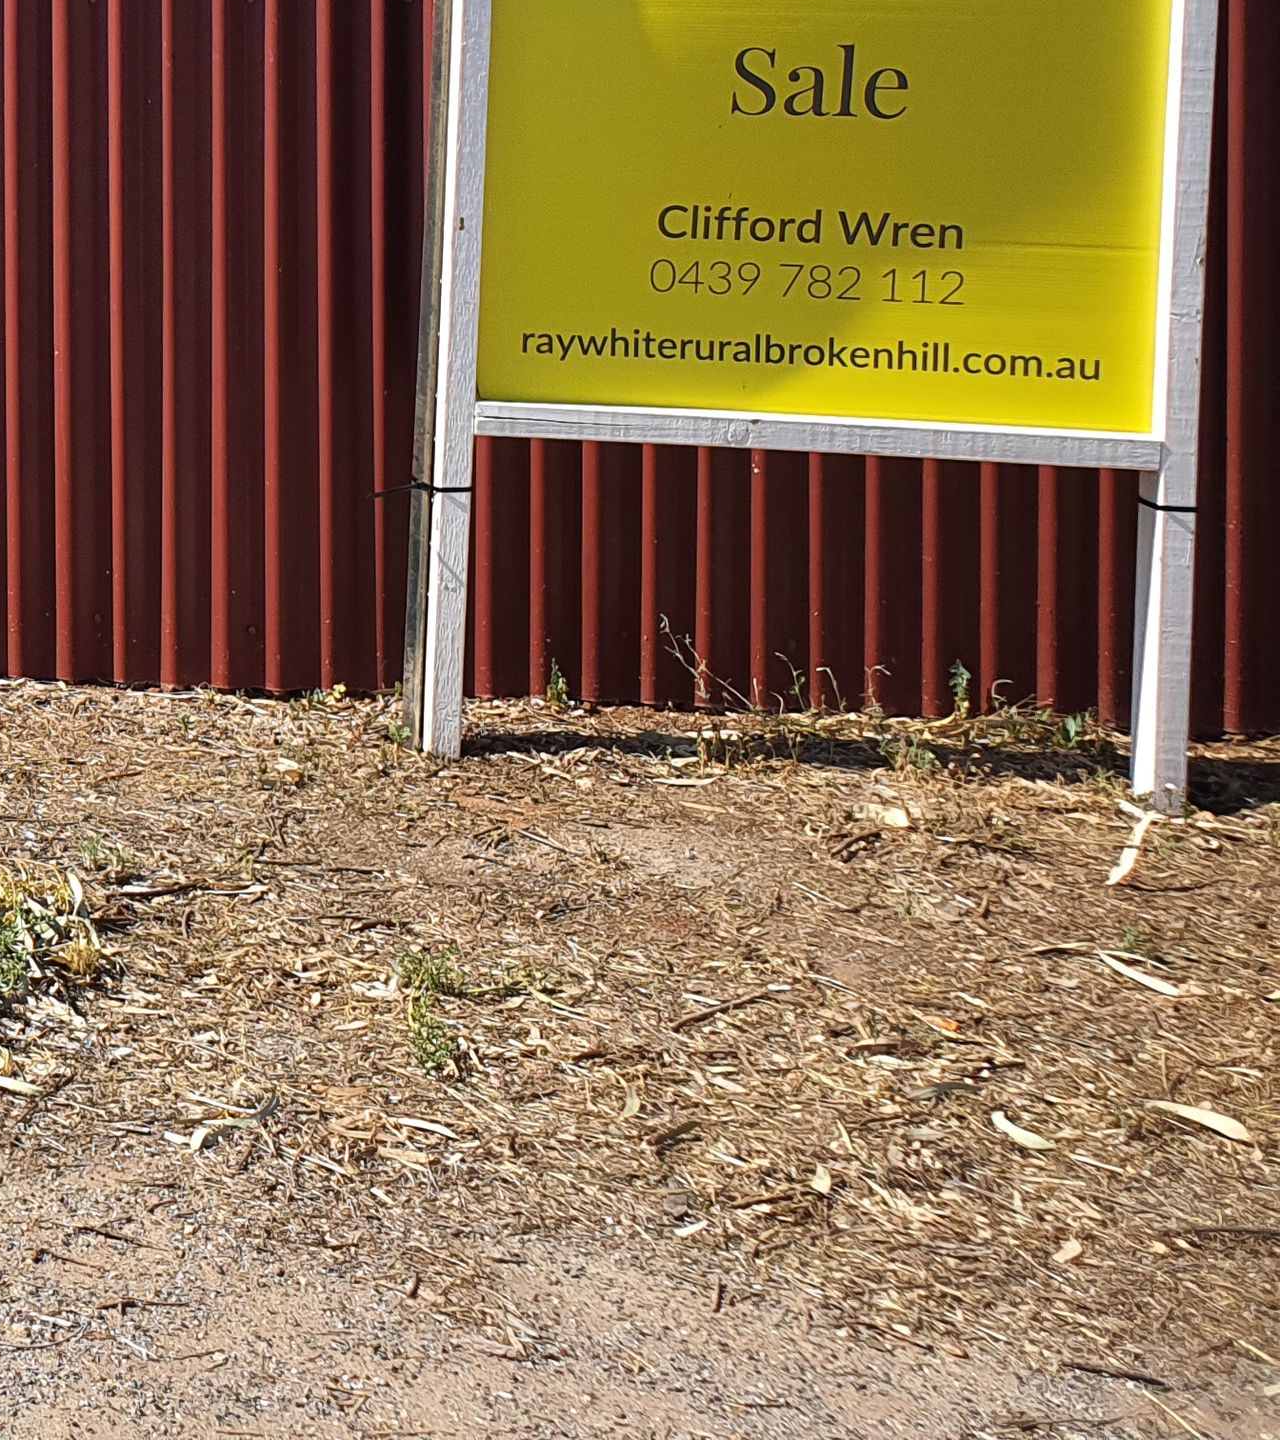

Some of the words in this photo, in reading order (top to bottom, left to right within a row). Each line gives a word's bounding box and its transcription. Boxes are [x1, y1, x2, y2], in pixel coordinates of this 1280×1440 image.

[729, 43, 910, 120] Sale
[657, 203, 823, 245] Clifford
[837, 210, 965, 251] Wren
[649, 257, 762, 297] 0439
[778, 262, 863, 302] 782
[880, 266, 966, 307] 112
[520, 327, 1102, 382] raywhiteruralbrokenhill.com.au
